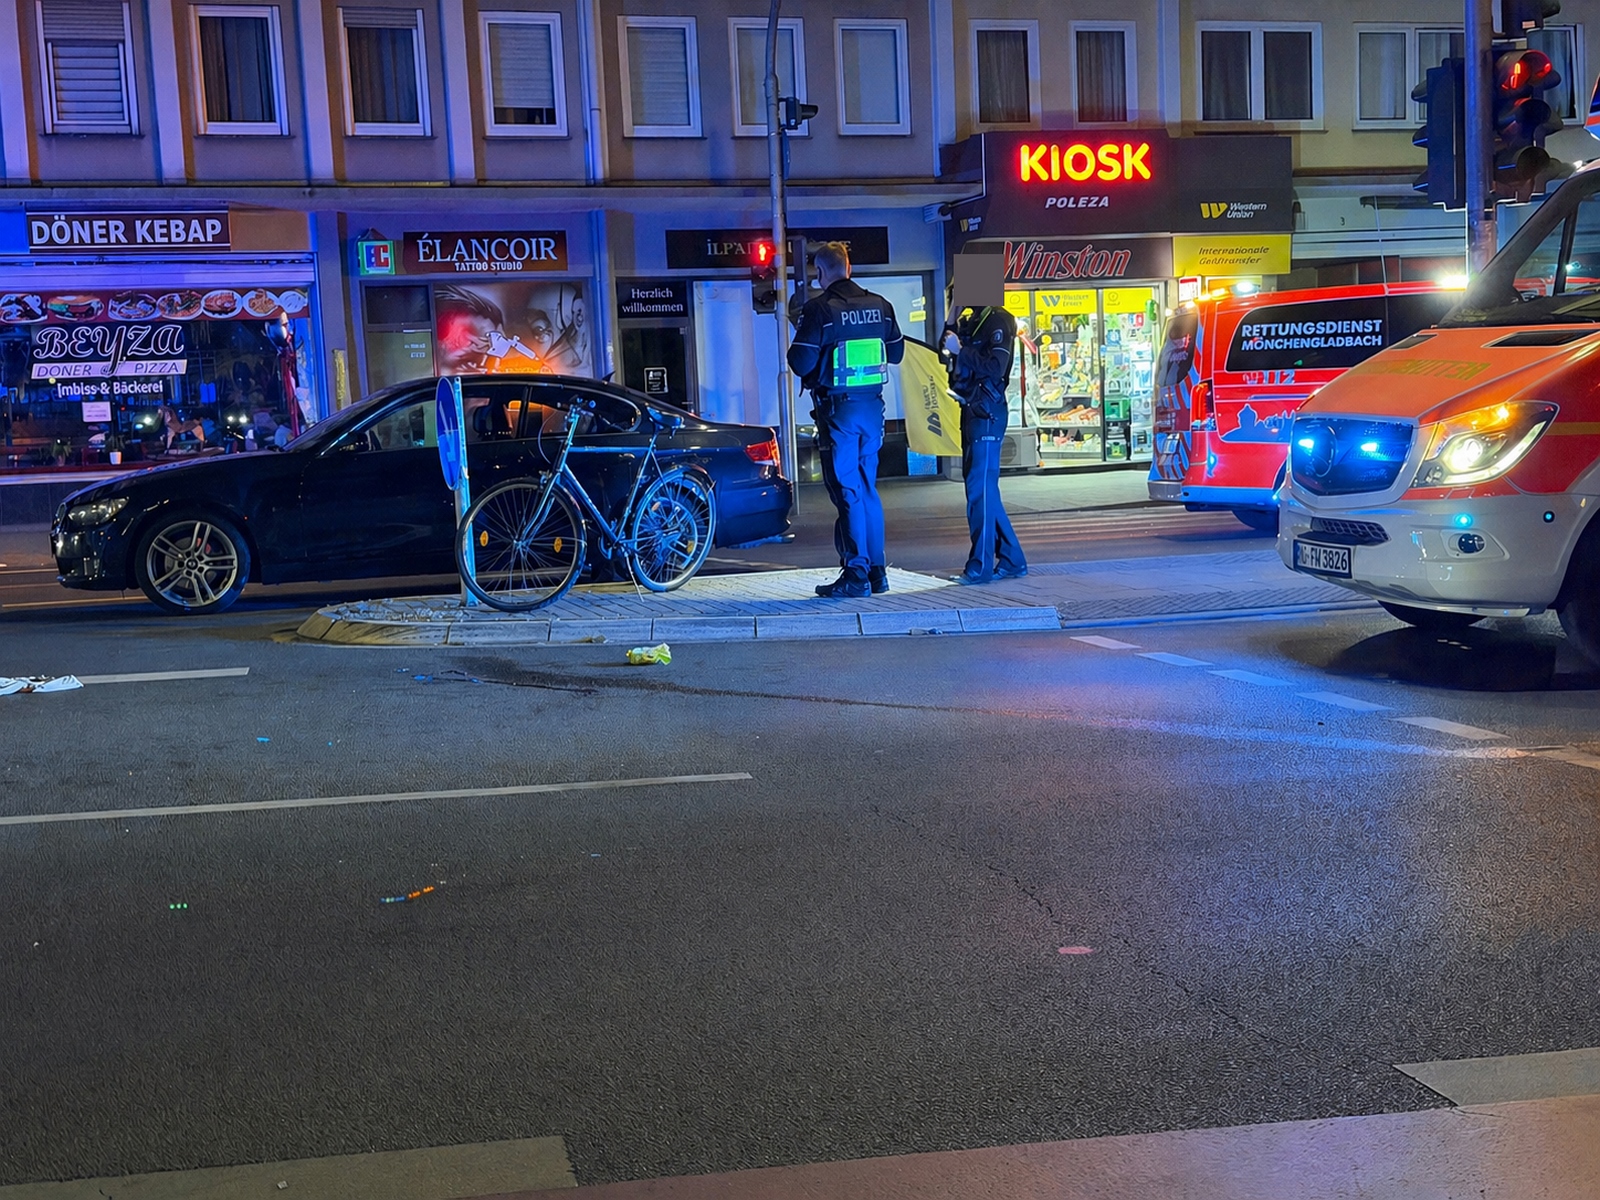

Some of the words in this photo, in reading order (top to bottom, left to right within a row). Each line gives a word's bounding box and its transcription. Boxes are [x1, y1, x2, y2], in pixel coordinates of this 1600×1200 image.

[1019, 142, 1152, 183] KIOSK
[1045, 195, 1109, 210] POLEZA
[31, 214, 129, 246] DÖNER
[135, 217, 223, 244] KEBAP
[417, 233, 558, 263] ÉLANCOIR
[1198, 245, 1270, 255] Internationale
[454, 262, 489, 272] TATTOO
[490, 261, 523, 271] STUDIO
[1004, 241, 1132, 279] Winston
[631, 287, 673, 300] Herzlich
[622, 301, 684, 314] willkommen
[841, 309, 882, 326] POLIZEI
[1241, 318, 1383, 337] RETTUNGSDIENST
[33, 324, 185, 377] BEYZA
[1241, 334, 1383, 351] MÖNCHENGLADBACH
[134, 362, 179, 374] PIZZA
[57, 382, 97, 398] Imbiss
[100, 382, 110, 395] &
[113, 380, 164, 395] Bäckerei
[1323, 549, 1348, 571] 3826
